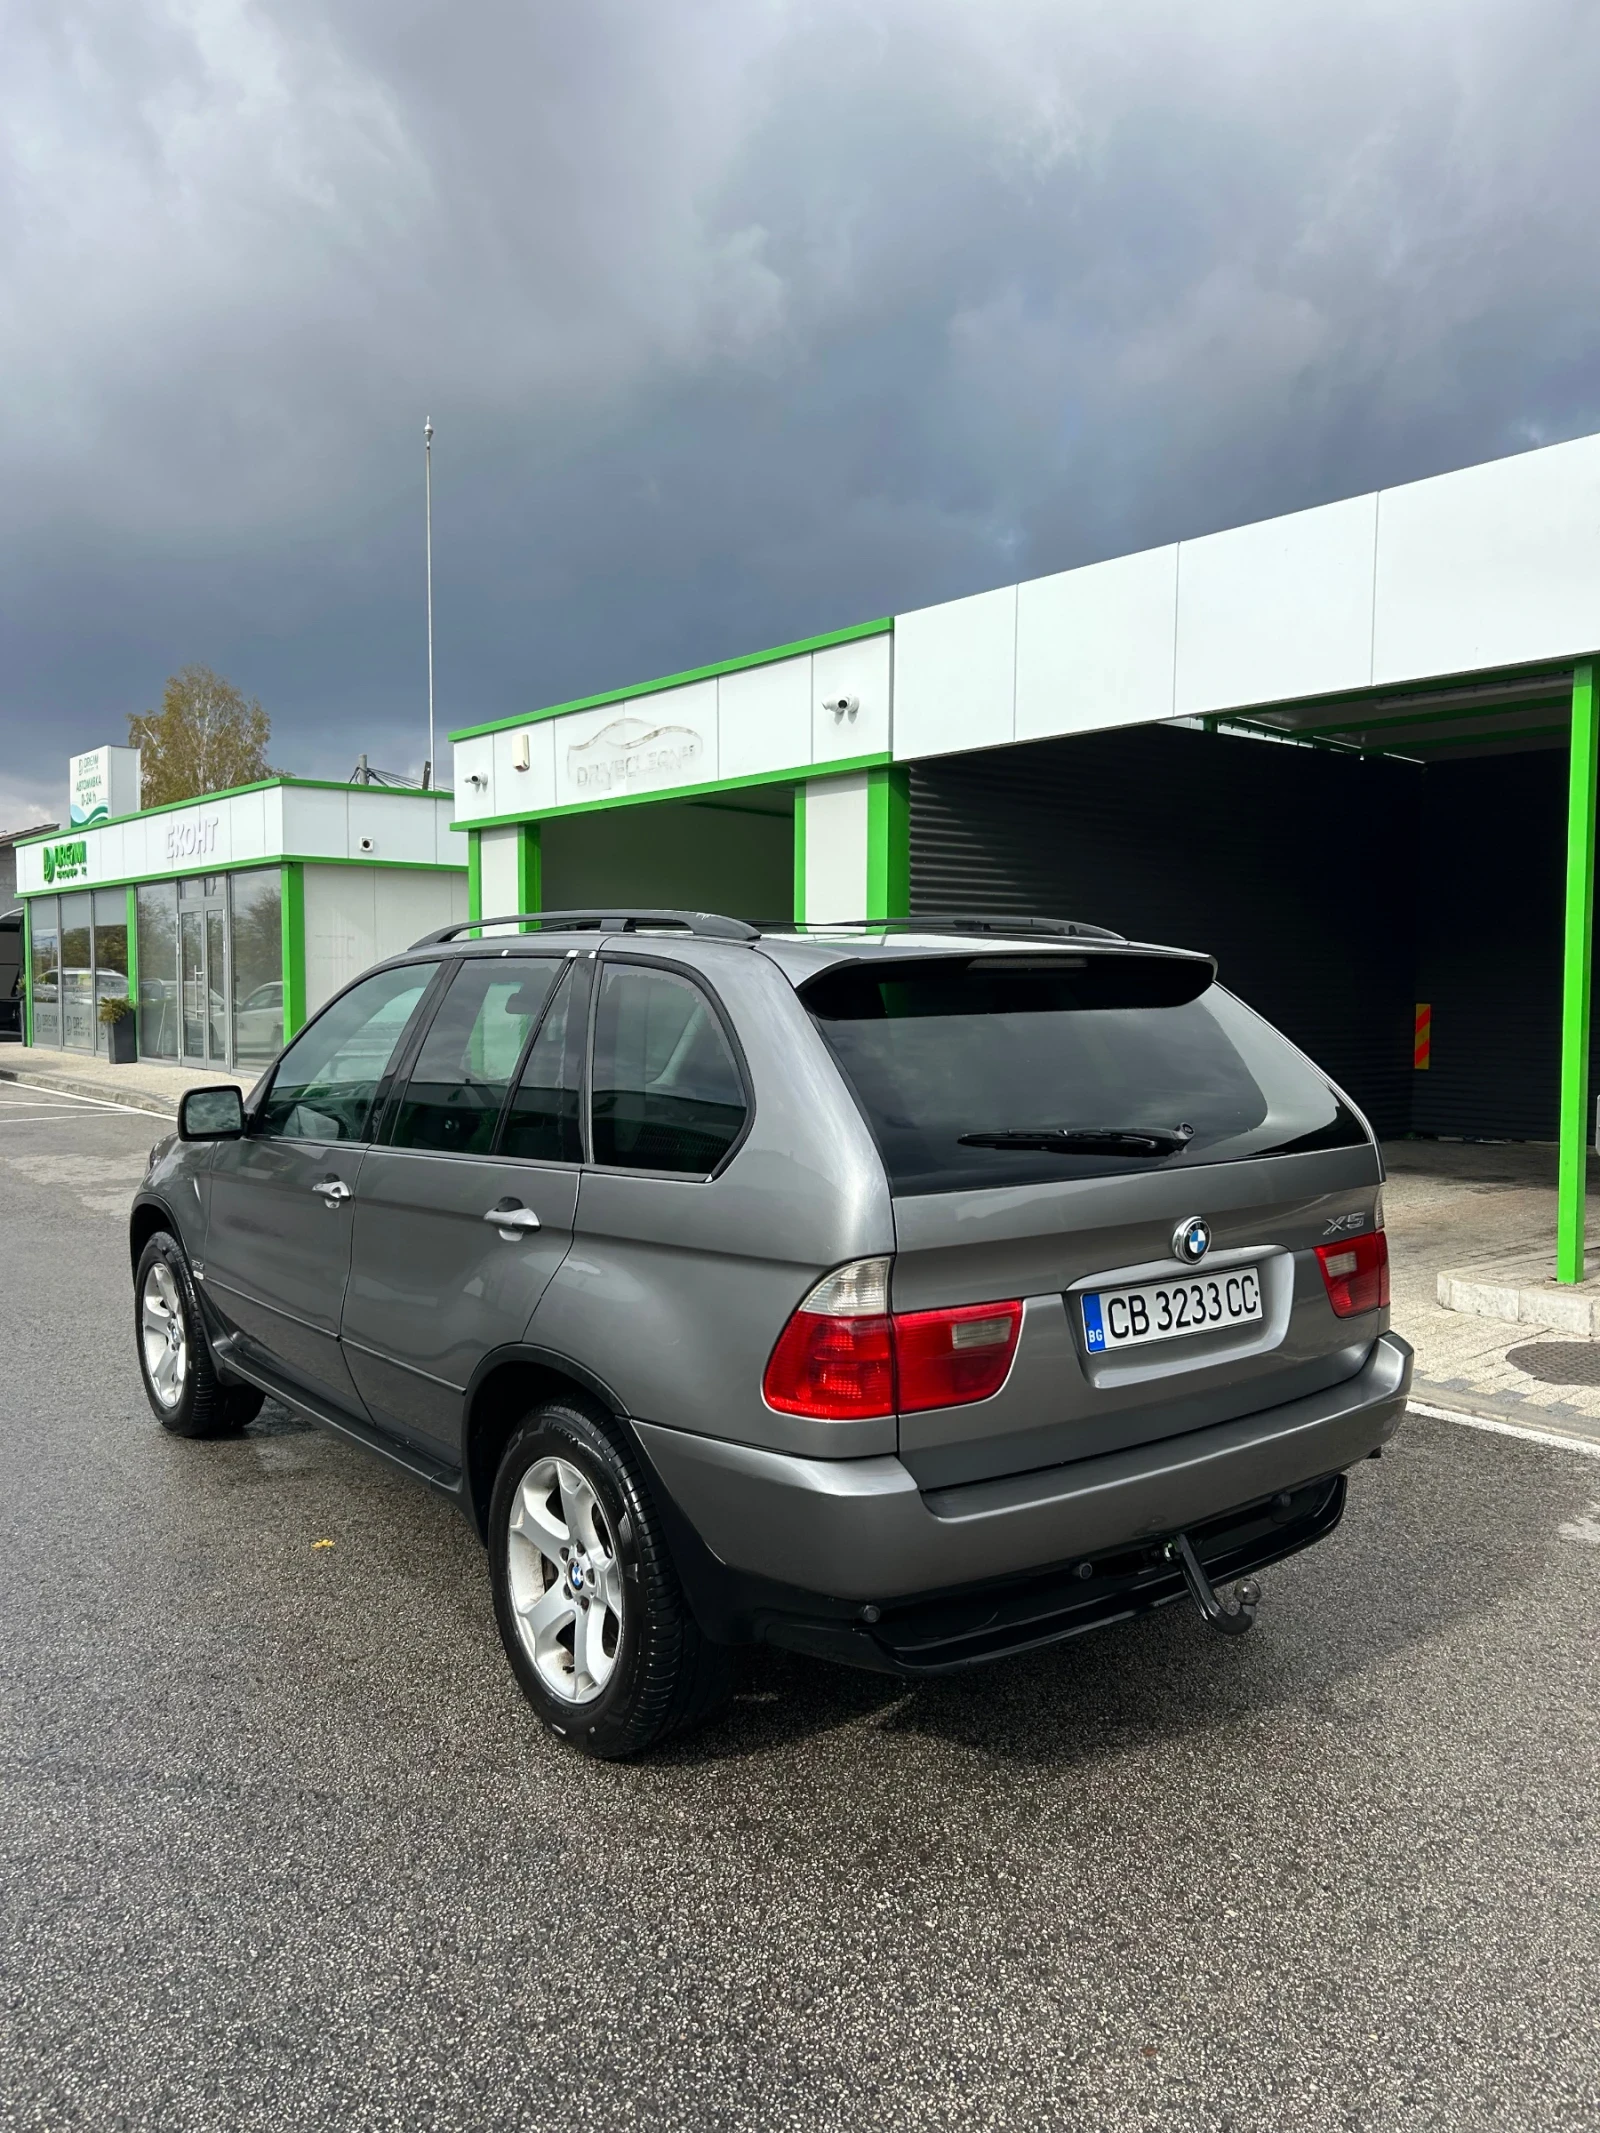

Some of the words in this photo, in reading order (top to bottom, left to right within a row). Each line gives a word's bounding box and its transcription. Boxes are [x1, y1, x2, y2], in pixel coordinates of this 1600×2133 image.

[1322, 1211, 1366, 1236] X5
[1107, 1294, 1150, 1339] CB
[1155, 1282, 1222, 1331] 3233
[1226, 1275, 1257, 1317] CC
[1088, 1329, 1103, 1343] BG
